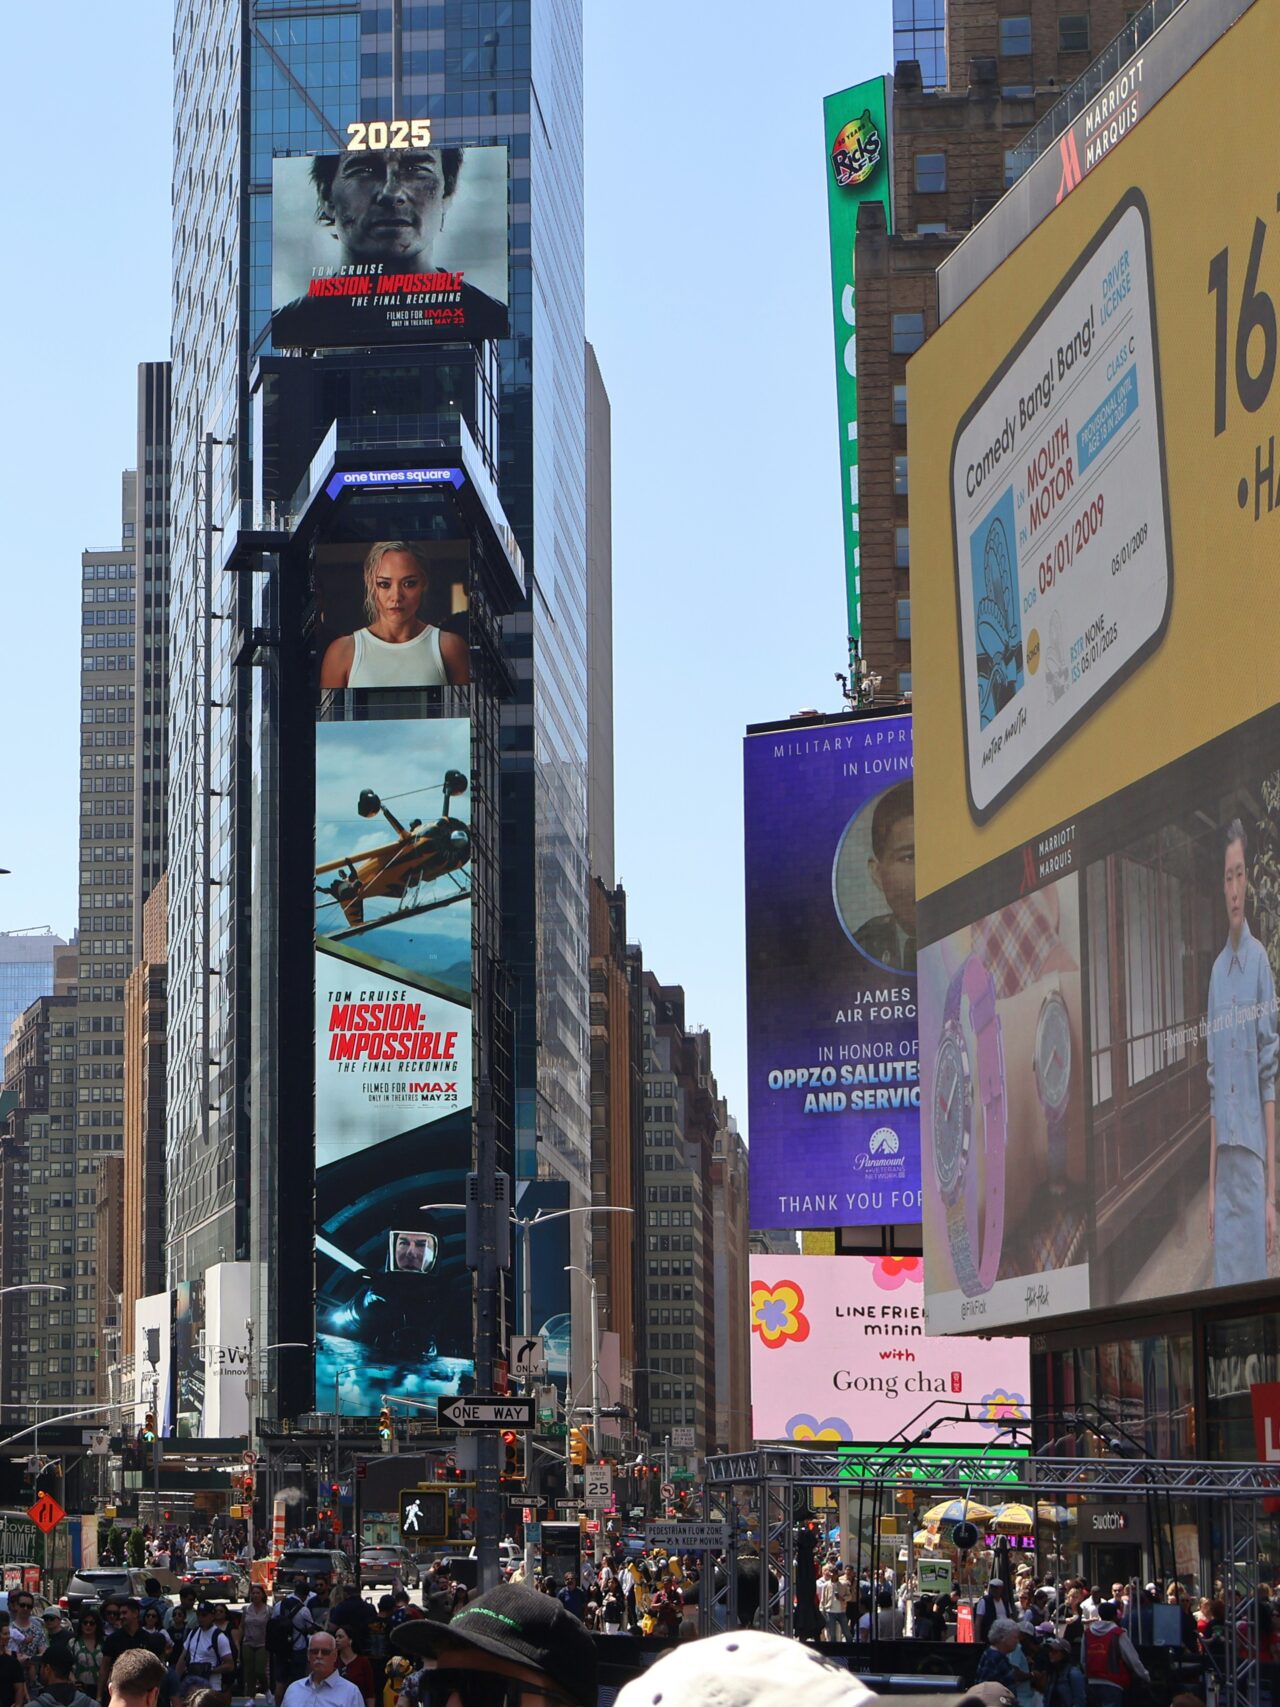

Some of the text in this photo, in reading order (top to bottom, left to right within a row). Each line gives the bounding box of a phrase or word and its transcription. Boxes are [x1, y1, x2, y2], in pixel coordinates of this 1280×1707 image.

[1085, 59, 1144, 137] MARRIOTT
[347, 119, 431, 151] 2025
[1086, 100, 1138, 170] MARQUIS
[312, 264, 383, 277] TOM CRUISE
[1102, 249, 1130, 299] DRIVER
[307, 272, 464, 298] MISSION: IMPOSSIBLE
[352, 292, 461, 307] THE FINAL RECKONING
[1100, 272, 1132, 326] LICENSE
[387, 308, 464, 319] FILMED FOR IMAX
[1106, 336, 1135, 382] CLASS C
[966, 303, 1096, 499] Comedy Bang! Bang!
[1081, 397, 1117, 448] PROVISIONAL
[1088, 434, 1100, 456] AGE
[1027, 417, 1069, 498] MOUTH
[344, 470, 450, 483] one times square
[1030, 457, 1074, 536] MOTOR
[1023, 493, 1104, 614] DOB 05/01/2009
[1111, 522, 1148, 576] 05/01/2009
[1084, 613, 1105, 646] NONE
[1081, 622, 1118, 674] 05/01/2025
[774, 736, 853, 758] MILITARY
[982, 706, 1027, 769] MOTOR MOUTH
[843, 762, 858, 777] IN
[1038, 825, 1076, 855] MARRIOTT
[1039, 852, 1072, 878] MARQUIS
[328, 990, 407, 1002] TOM CRUISE
[854, 987, 911, 1004] JAMES
[329, 1004, 426, 1031] MISSION:
[835, 1004, 917, 1023] AIR FORC
[1162, 1023, 1198, 1051] Honoring
[1199, 1016, 1212, 1038] the
[328, 1032, 458, 1060] IMPOSSIBLE
[818, 1040, 919, 1061] IN HONOR OF
[338, 1061, 458, 1073] THE FINAL RECKONING
[768, 1066, 837, 1090] OPPZO
[363, 1082, 458, 1093] FILMED FOR IMAX
[368, 1094, 383, 1102] ONLY
[444, 1093, 458, 1101] 23
[803, 1086, 921, 1113] AND SERVIC
[853, 1152, 905, 1170] Paramount
[779, 1192, 883, 1213] THANK YOU
[835, 1306, 876, 1318] LINE
[864, 1324, 922, 1336] minin
[879, 1349, 915, 1361] with
[516, 1364, 539, 1373] ONLY
[833, 1370, 899, 1399] Gong
[905, 1370, 946, 1393] cha
[453, 1406, 523, 1420] ONE WAY
[588, 1482, 609, 1496] 25
[649, 1526, 723, 1535] PEDESTRIAN FLOW ZONE
[1092, 1511, 1120, 1531] swatch
[682, 1538, 723, 1546] KEEP MOVING
